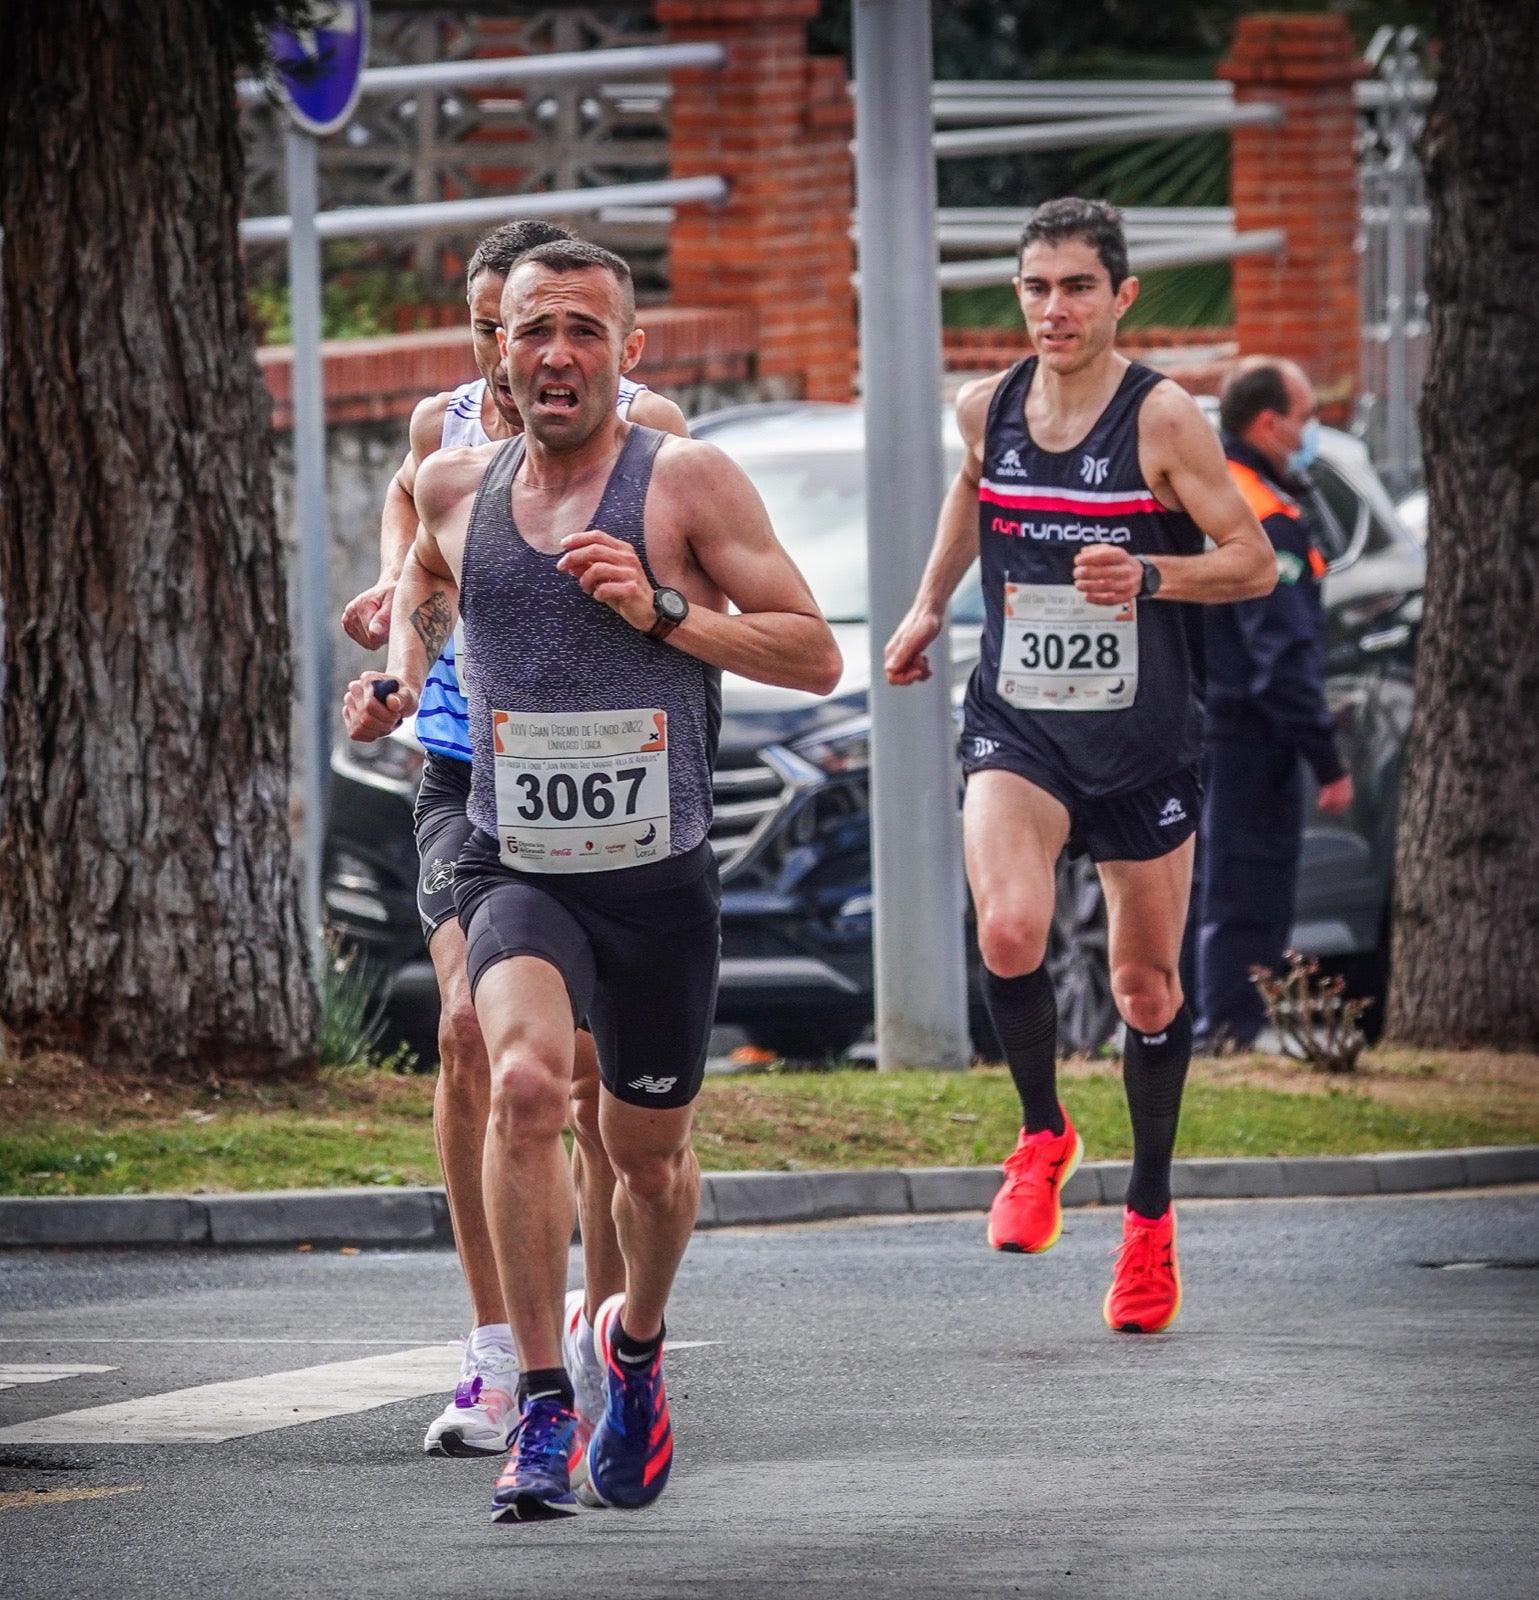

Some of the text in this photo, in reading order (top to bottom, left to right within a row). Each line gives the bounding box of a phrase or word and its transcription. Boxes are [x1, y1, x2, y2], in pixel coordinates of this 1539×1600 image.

[991, 516, 1132, 544] runrundata
[1020, 632, 1121, 670] 3028
[621, 719, 644, 734] 2022
[515, 766, 648, 822] 3067
